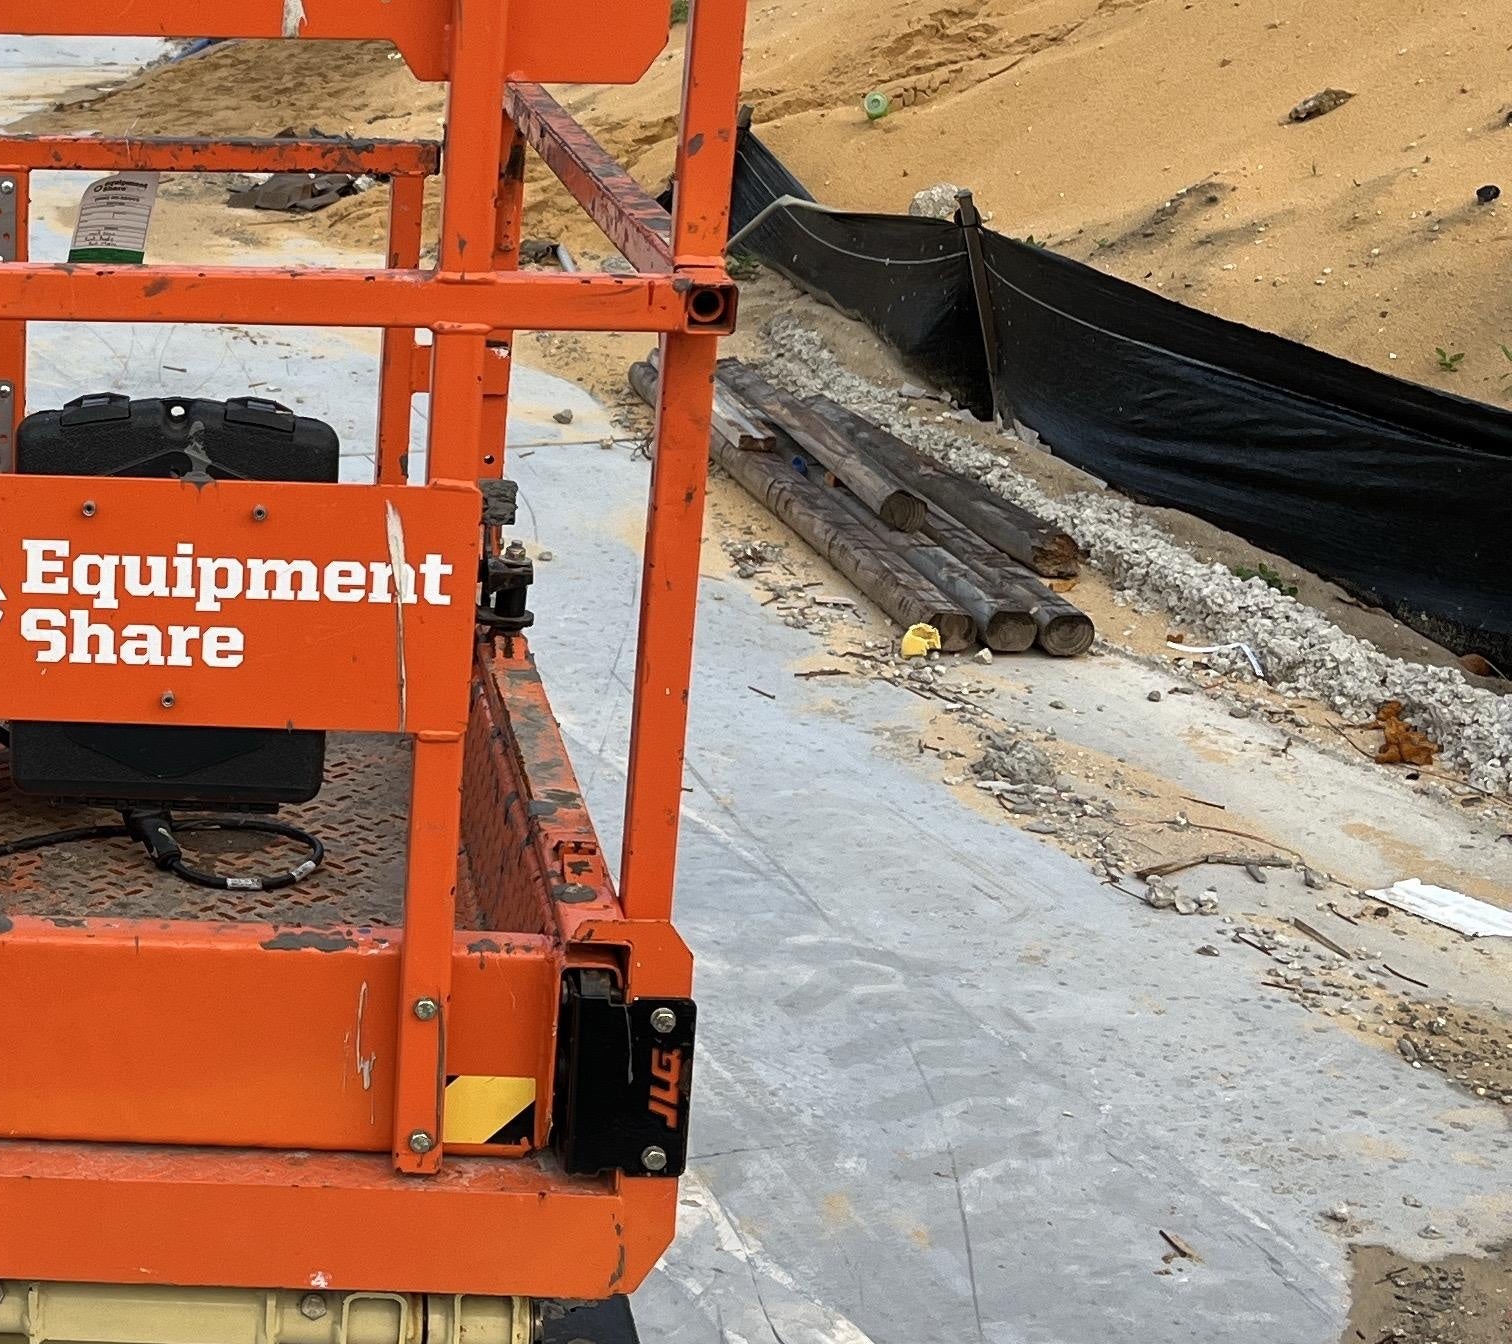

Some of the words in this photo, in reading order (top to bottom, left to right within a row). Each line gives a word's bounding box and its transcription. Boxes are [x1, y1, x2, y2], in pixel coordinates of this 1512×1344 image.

[20, 538, 454, 612] Equipment
[19, 607, 245, 669] Share
[647, 1046, 684, 1131] JLG
